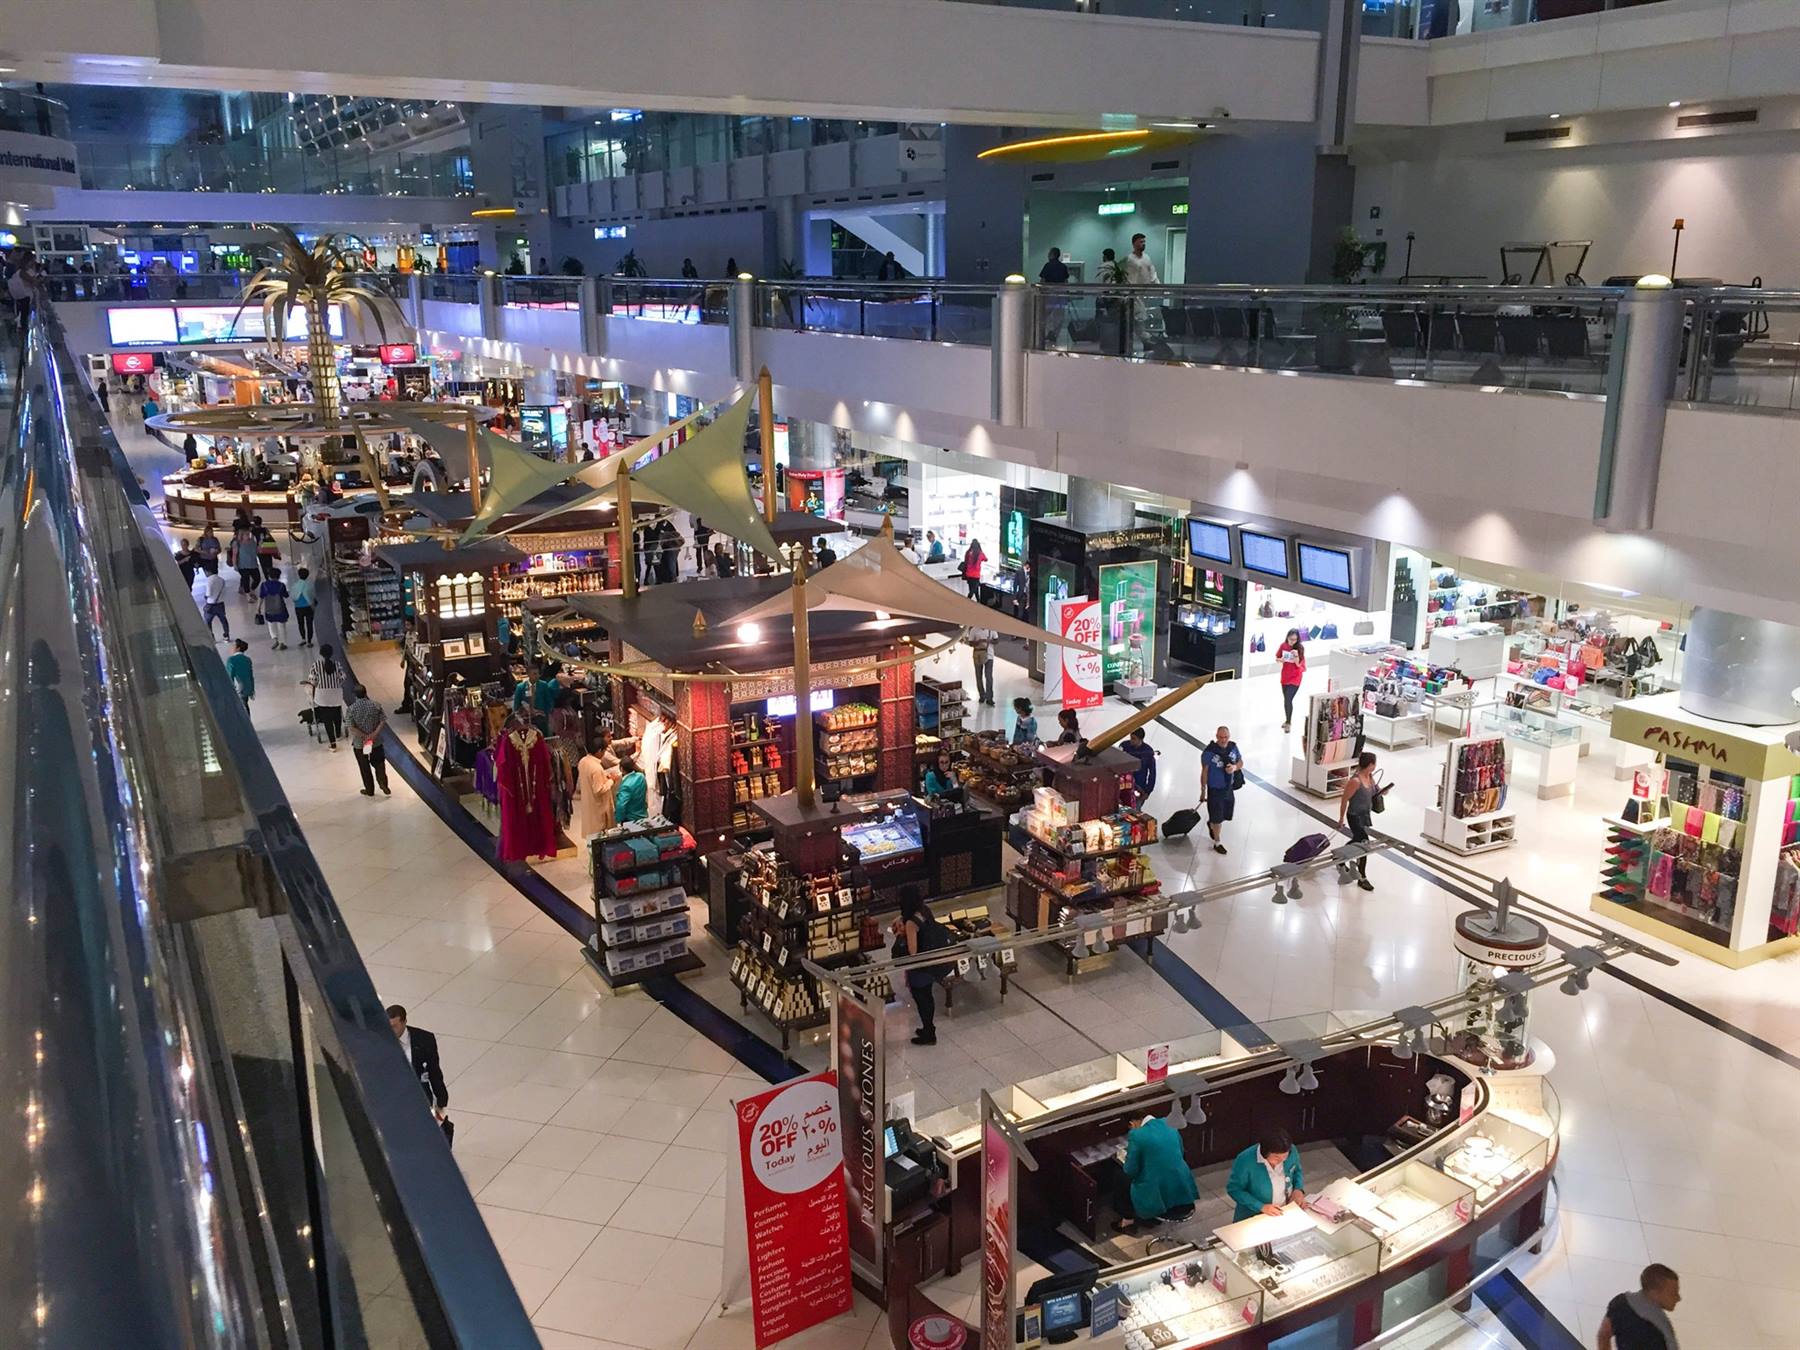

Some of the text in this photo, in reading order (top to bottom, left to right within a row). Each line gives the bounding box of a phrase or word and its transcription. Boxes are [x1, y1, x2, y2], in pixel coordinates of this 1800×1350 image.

[1074, 616, 1100, 632] 20%
[1074, 630, 1100, 644] OFF
[1488, 951, 1536, 960] PRECIOUS
[804, 1100, 832, 1124] خصم
[760, 1114, 798, 1142] 20%
[860, 1038, 874, 1229] PRECIOUS STONES
[762, 1132, 797, 1156] OFF
[807, 1138, 830, 1158] اليوم
[766, 1154, 796, 1170] Today
[754, 1201, 786, 1218] Perfumes
[754, 1211, 788, 1228] Cosmetics
[755, 1224, 784, 1240] Watches
[756, 1240, 773, 1250] Pens
[758, 1246, 786, 1262] Lighters
[758, 1258, 784, 1272] Fashion
[758, 1266, 788, 1282] Precious
[760, 1272, 791, 1289] Jewellery
[760, 1282, 790, 1298] Costume
[760, 1288, 792, 1306] Jewellery
[761, 1297, 798, 1315] Sunglasses
[762, 1314, 784, 1328] Liquor
[763, 1324, 790, 1338] Tobacco
